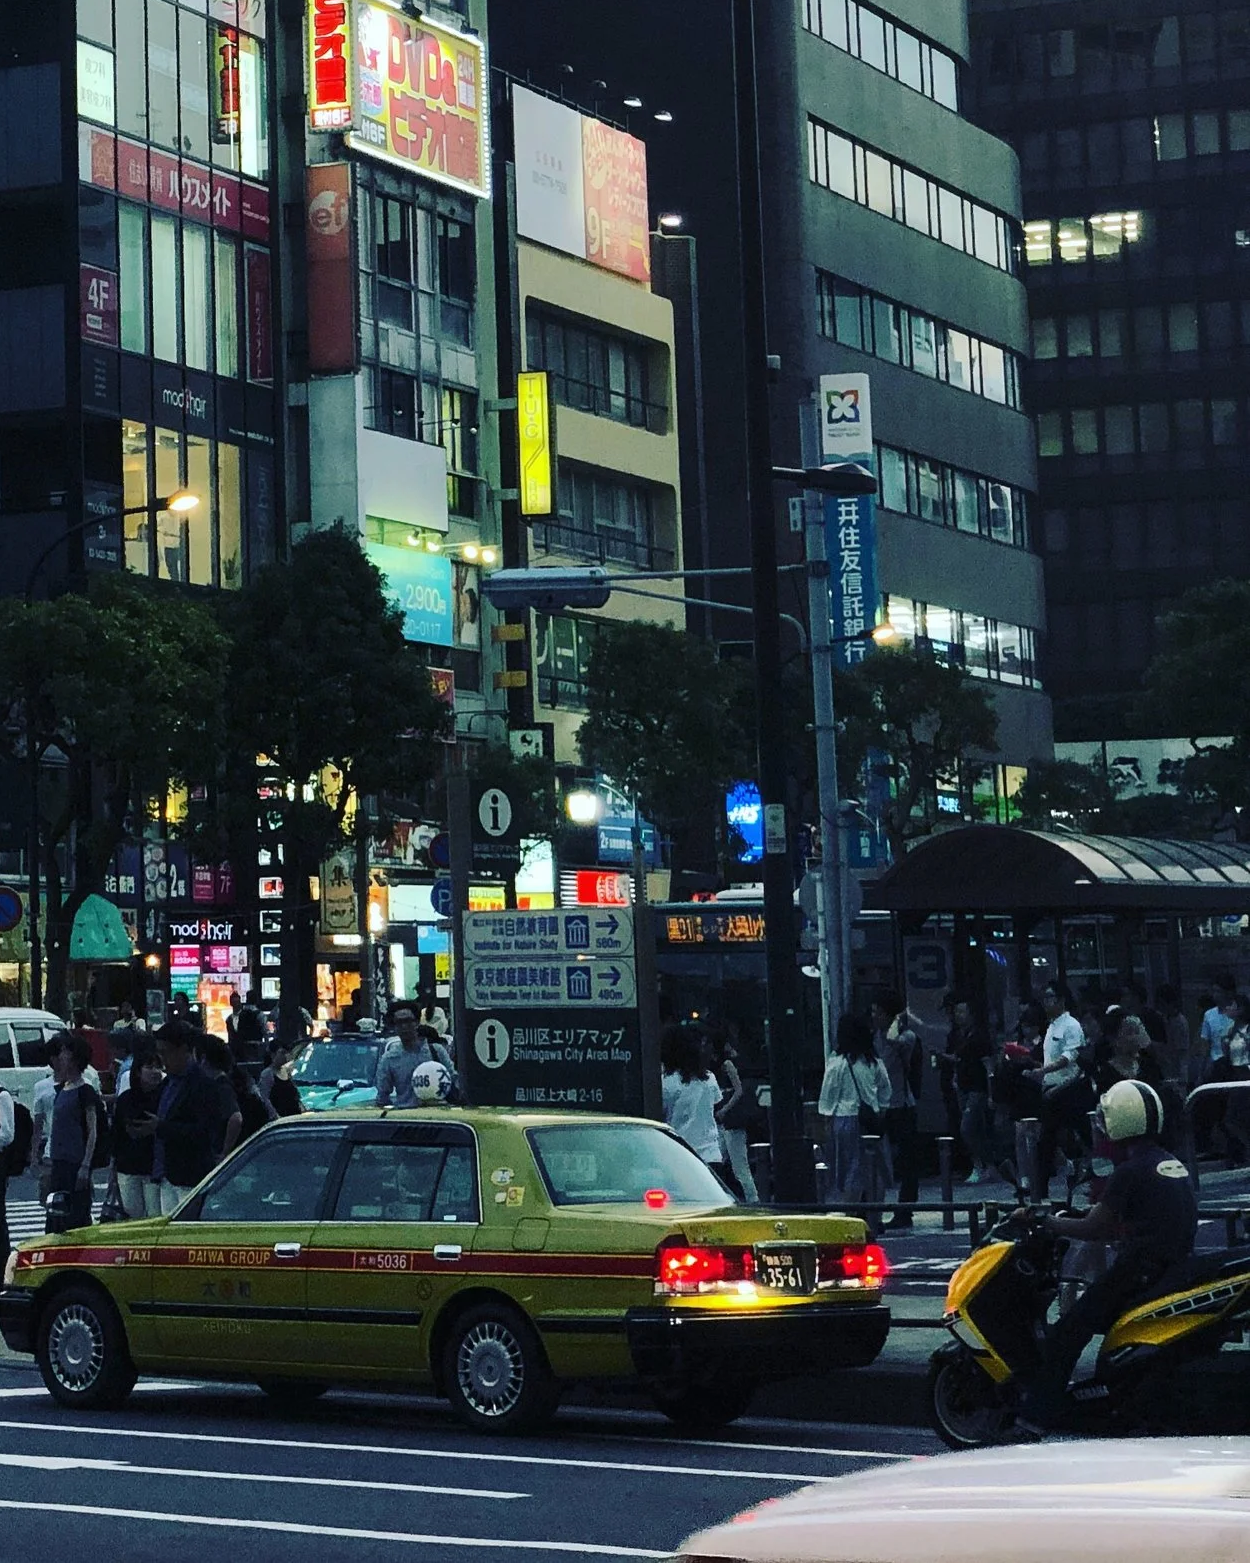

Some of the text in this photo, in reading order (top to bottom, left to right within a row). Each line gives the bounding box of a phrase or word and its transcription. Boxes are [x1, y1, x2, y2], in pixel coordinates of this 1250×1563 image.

[168, 169, 231, 218] ハウスメイト
[586, 206, 610, 260] 9F
[87, 277, 109, 311] 4F
[513, 1046, 632, 1064] Shinagawa City Area Map
[127, 1249, 151, 1263] TAXI
[188, 1249, 271, 1265] DAIWA GROUP
[377, 1253, 407, 1270] 5036
[767, 1267, 803, 1288] 35-61
